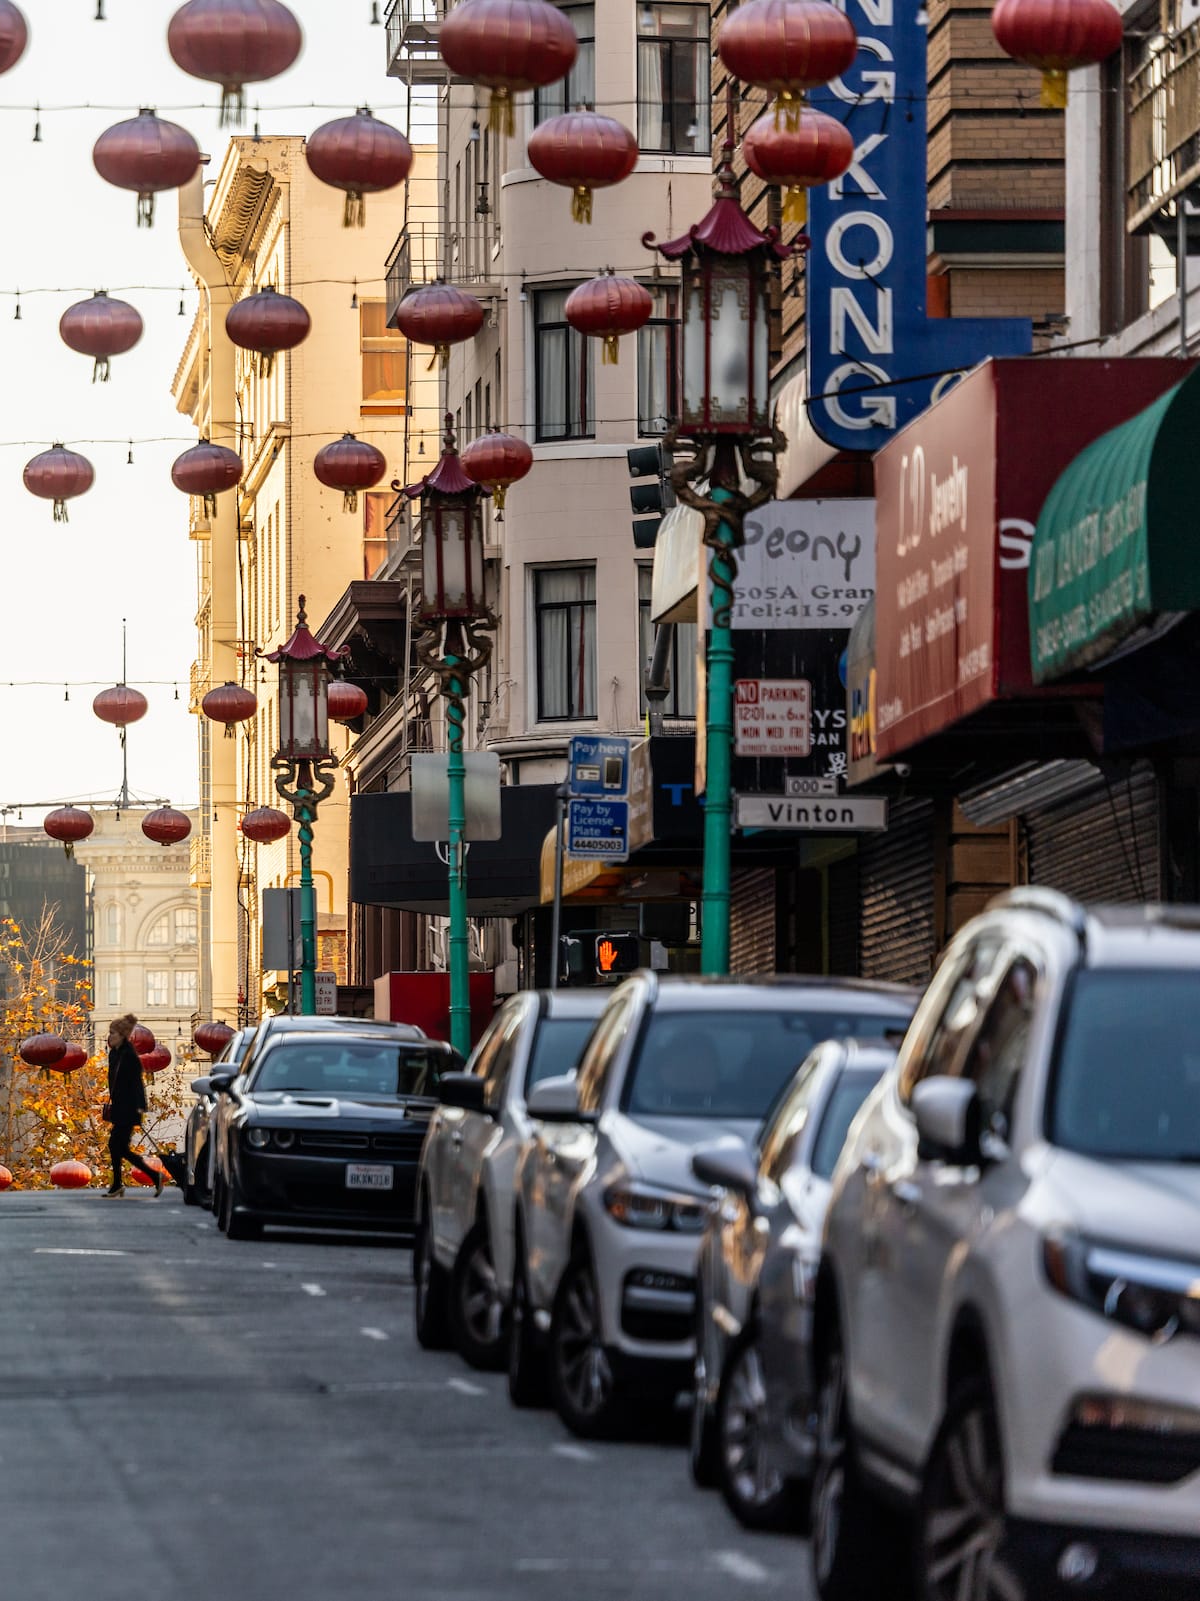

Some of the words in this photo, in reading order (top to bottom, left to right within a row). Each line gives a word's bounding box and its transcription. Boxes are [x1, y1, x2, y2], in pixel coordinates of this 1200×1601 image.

[824, 134, 896, 430] KONG
[737, 520, 861, 582] Peony
[738, 683, 757, 702] NO
[761, 688, 805, 701] PARKING
[742, 727, 760, 738] MON
[766, 727, 784, 738] WED
[790, 727, 804, 738] FRI
[574, 741, 597, 754] Pay
[599, 742, 627, 754] here
[573, 803, 593, 816] Pay
[596, 803, 611, 816] by
[767, 803, 855, 823] Vinton
[573, 815, 614, 825] License
[573, 826, 601, 836] Plate
